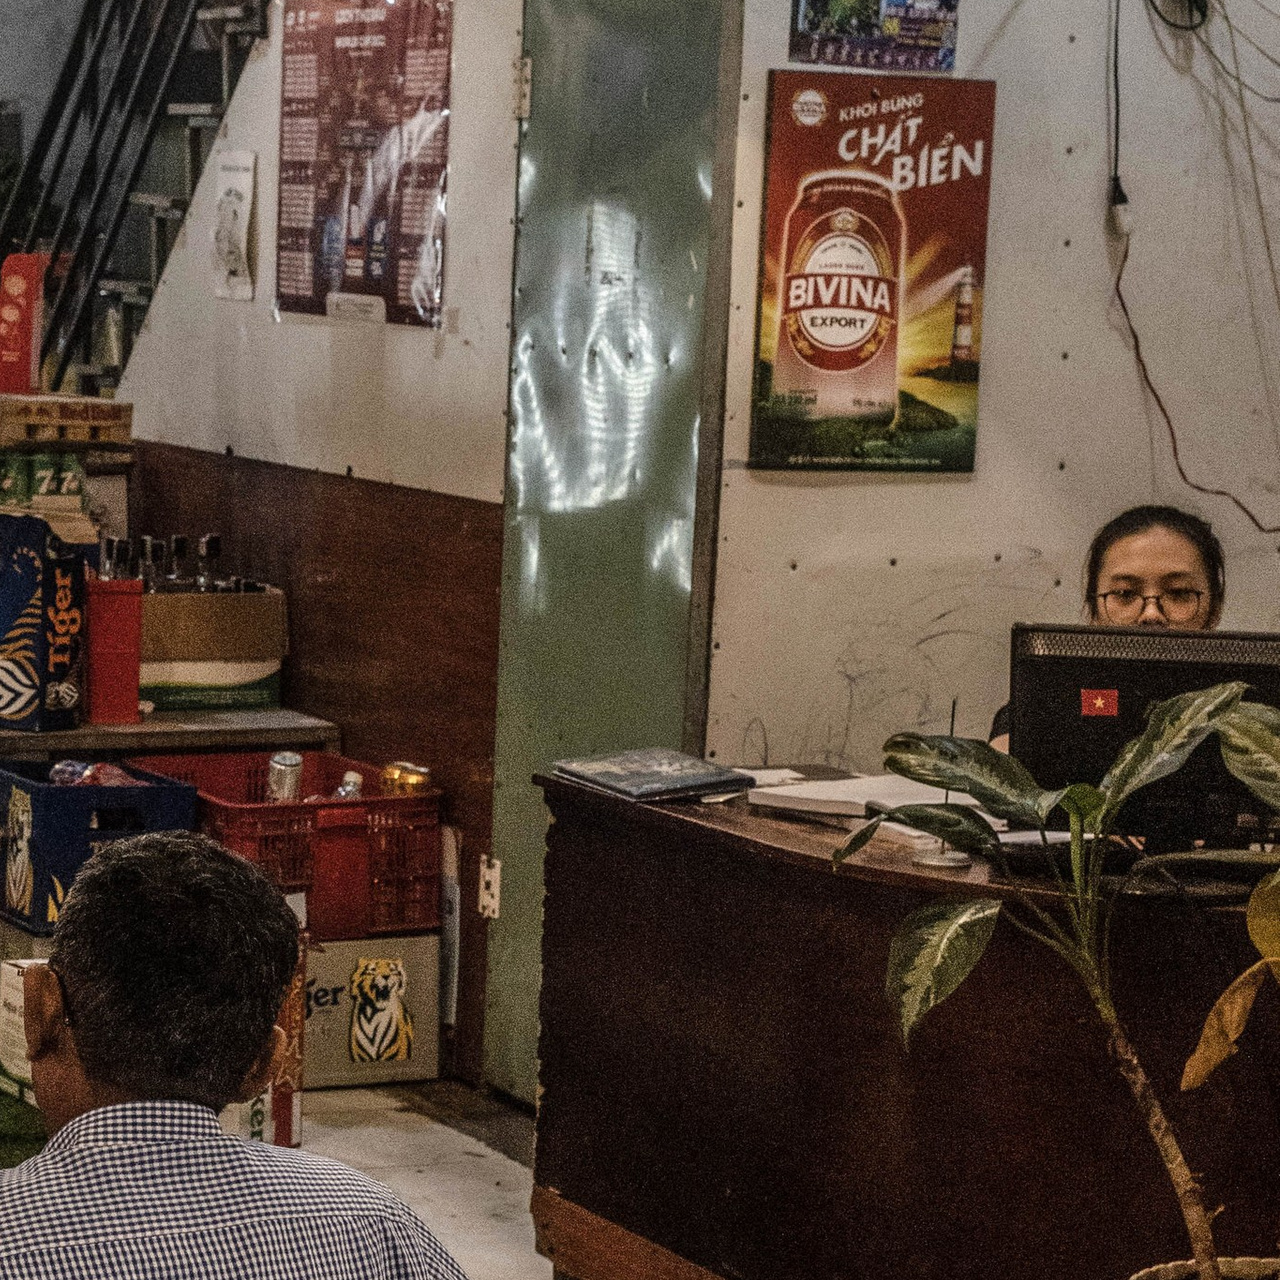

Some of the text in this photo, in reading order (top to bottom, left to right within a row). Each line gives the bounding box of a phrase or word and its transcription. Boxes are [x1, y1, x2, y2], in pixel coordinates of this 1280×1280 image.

[789, 275, 891, 314] BIVINA
[810, 315, 868, 329] EXPORT
[46, 567, 82, 674] Tiger
